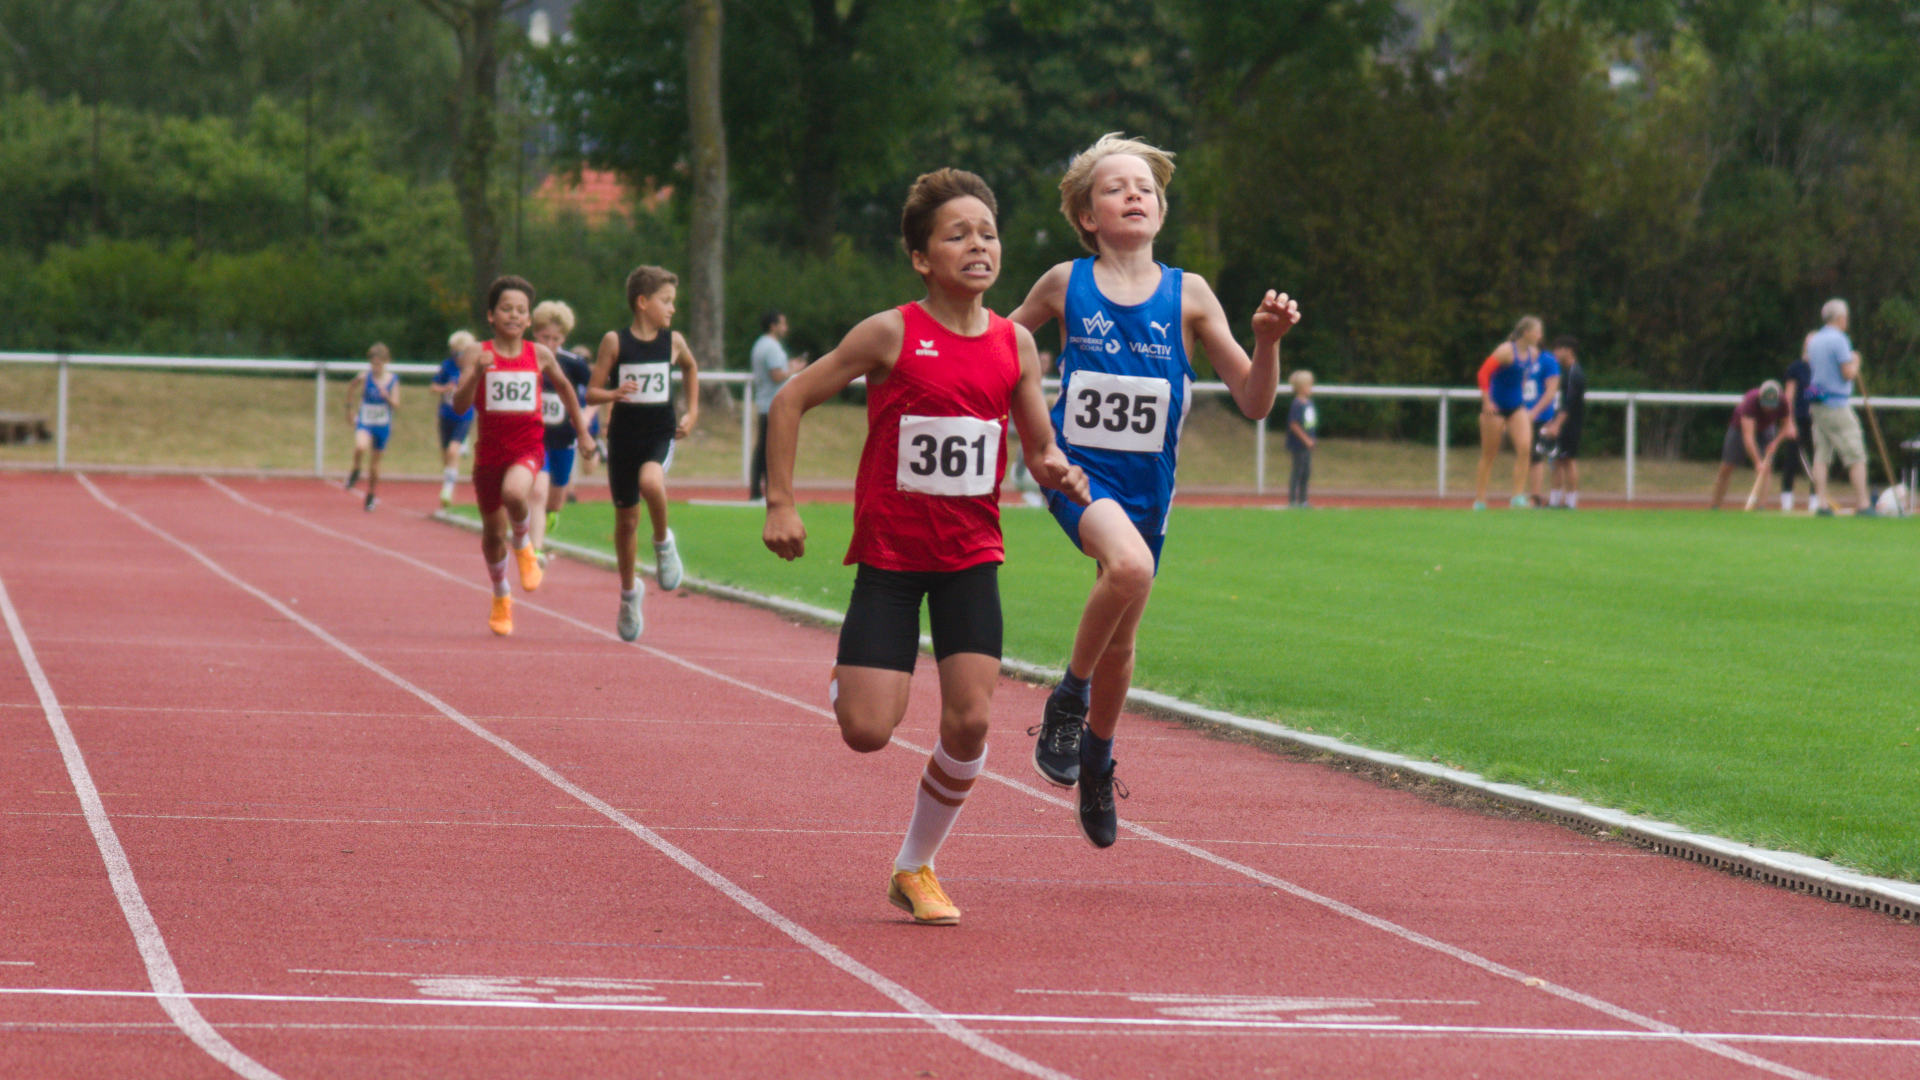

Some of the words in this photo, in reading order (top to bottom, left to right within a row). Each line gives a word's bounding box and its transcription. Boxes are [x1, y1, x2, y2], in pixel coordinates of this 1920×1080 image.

[1129, 342, 1172, 356] VIACTIV
[491, 380, 532, 402] 362
[1075, 388, 1158, 435] 335
[910, 434, 986, 477] 361
